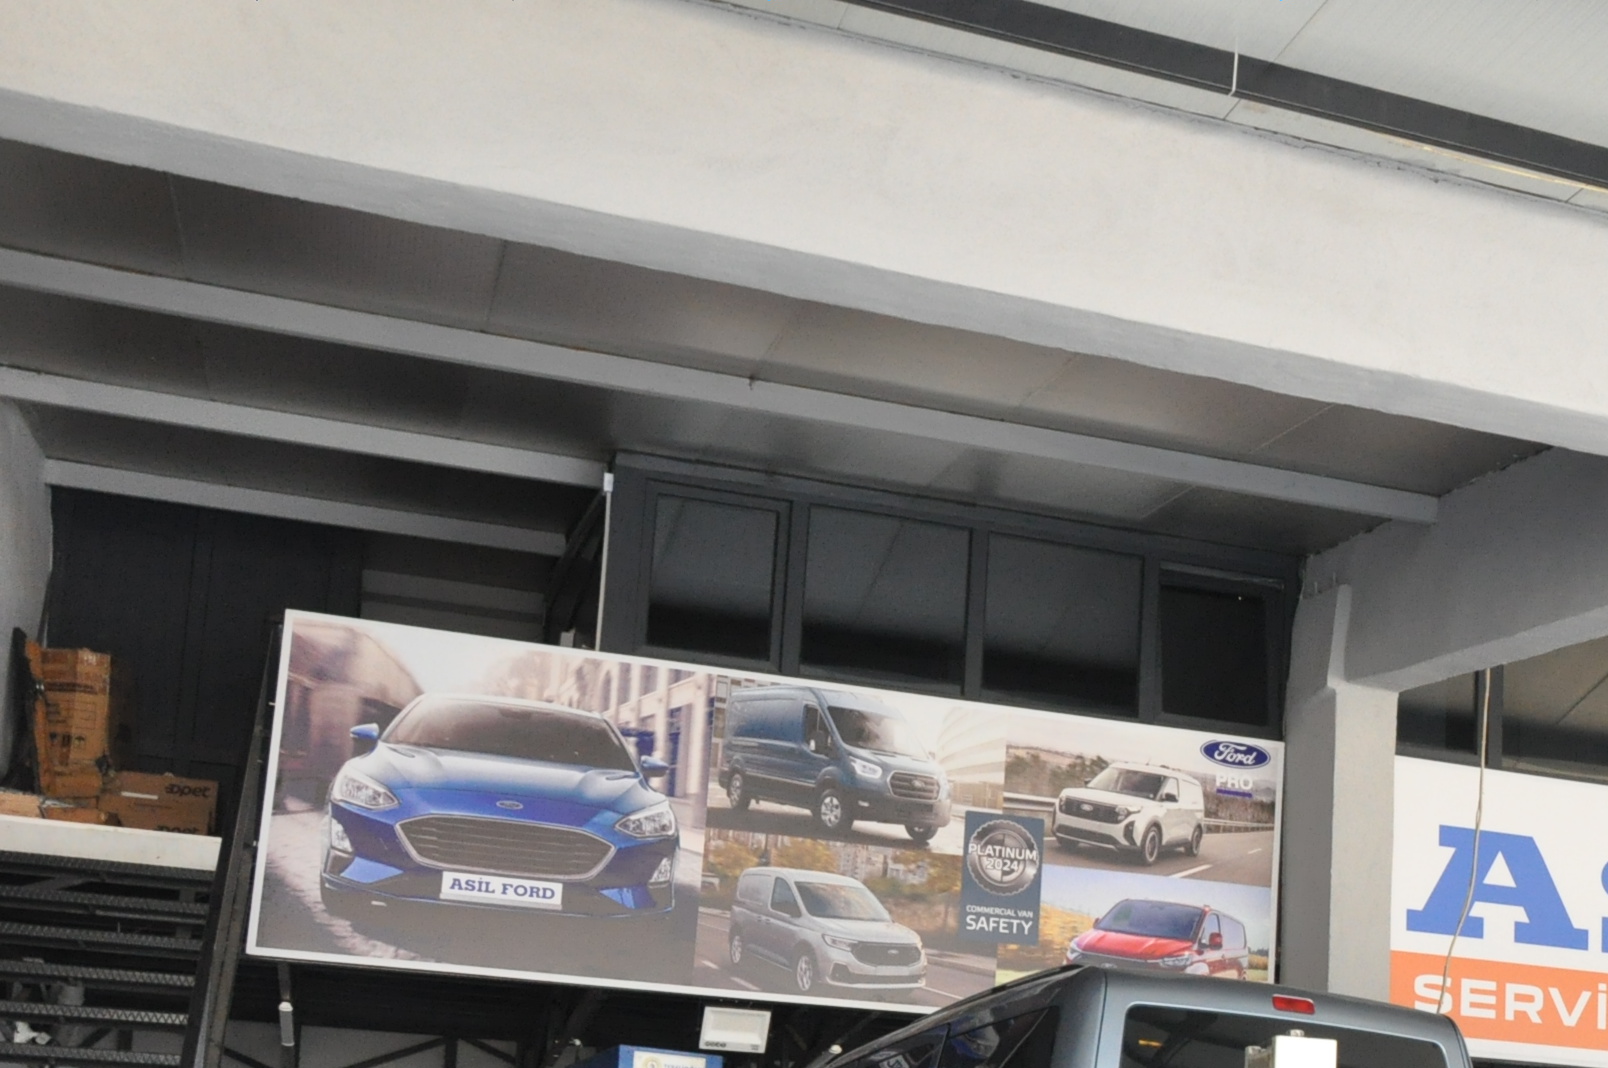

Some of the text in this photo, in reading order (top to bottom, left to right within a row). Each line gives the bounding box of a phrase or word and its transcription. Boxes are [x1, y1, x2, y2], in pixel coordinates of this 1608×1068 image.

[1213, 742, 1257, 765] Ford
[1216, 774, 1253, 790] PRO
[967, 843, 1038, 861] PLATINUM
[986, 857, 1019, 872] 2024
[449, 877, 556, 900] ASİL FORD
[965, 904, 1034, 919] COMMERCIAL VAN
[965, 914, 1033, 936] SAFETY
